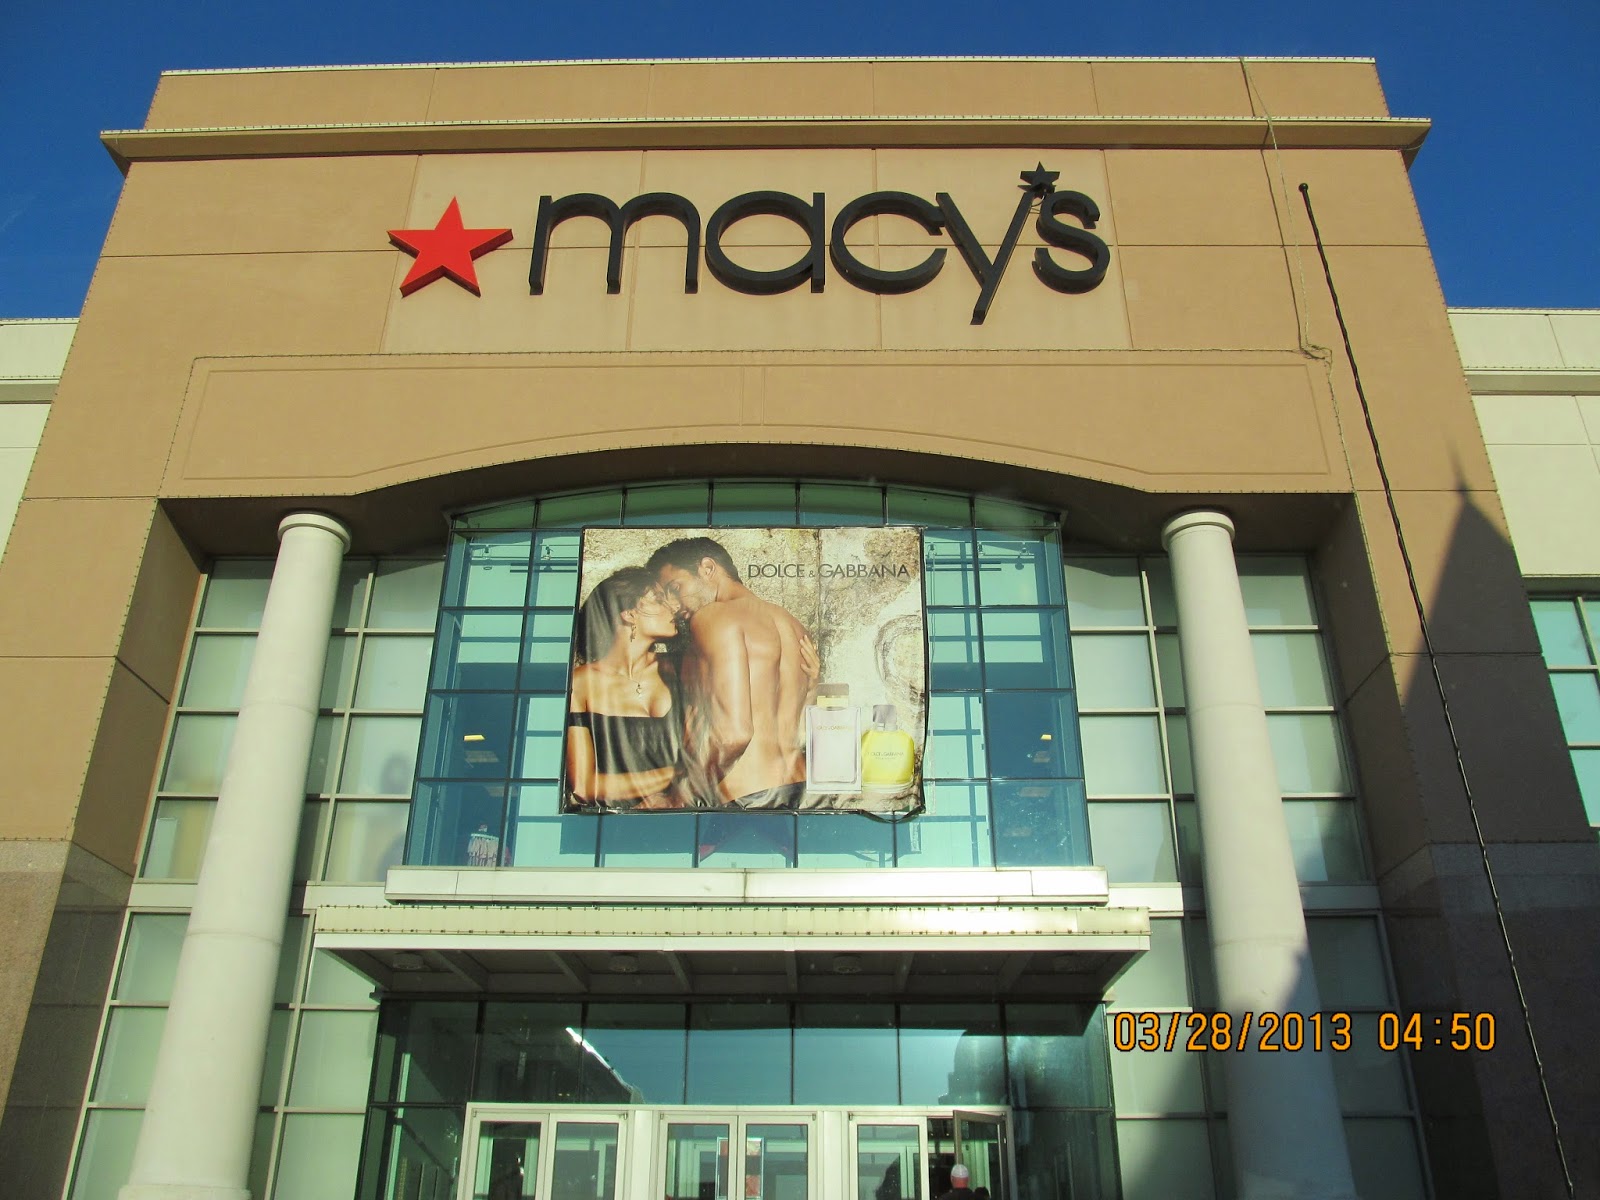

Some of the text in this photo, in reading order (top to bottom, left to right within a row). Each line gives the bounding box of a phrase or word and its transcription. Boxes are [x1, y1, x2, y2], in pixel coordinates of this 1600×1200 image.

[529, 161, 1110, 325] macy's
[748, 563, 911, 578] DOLCE & GABBANA
